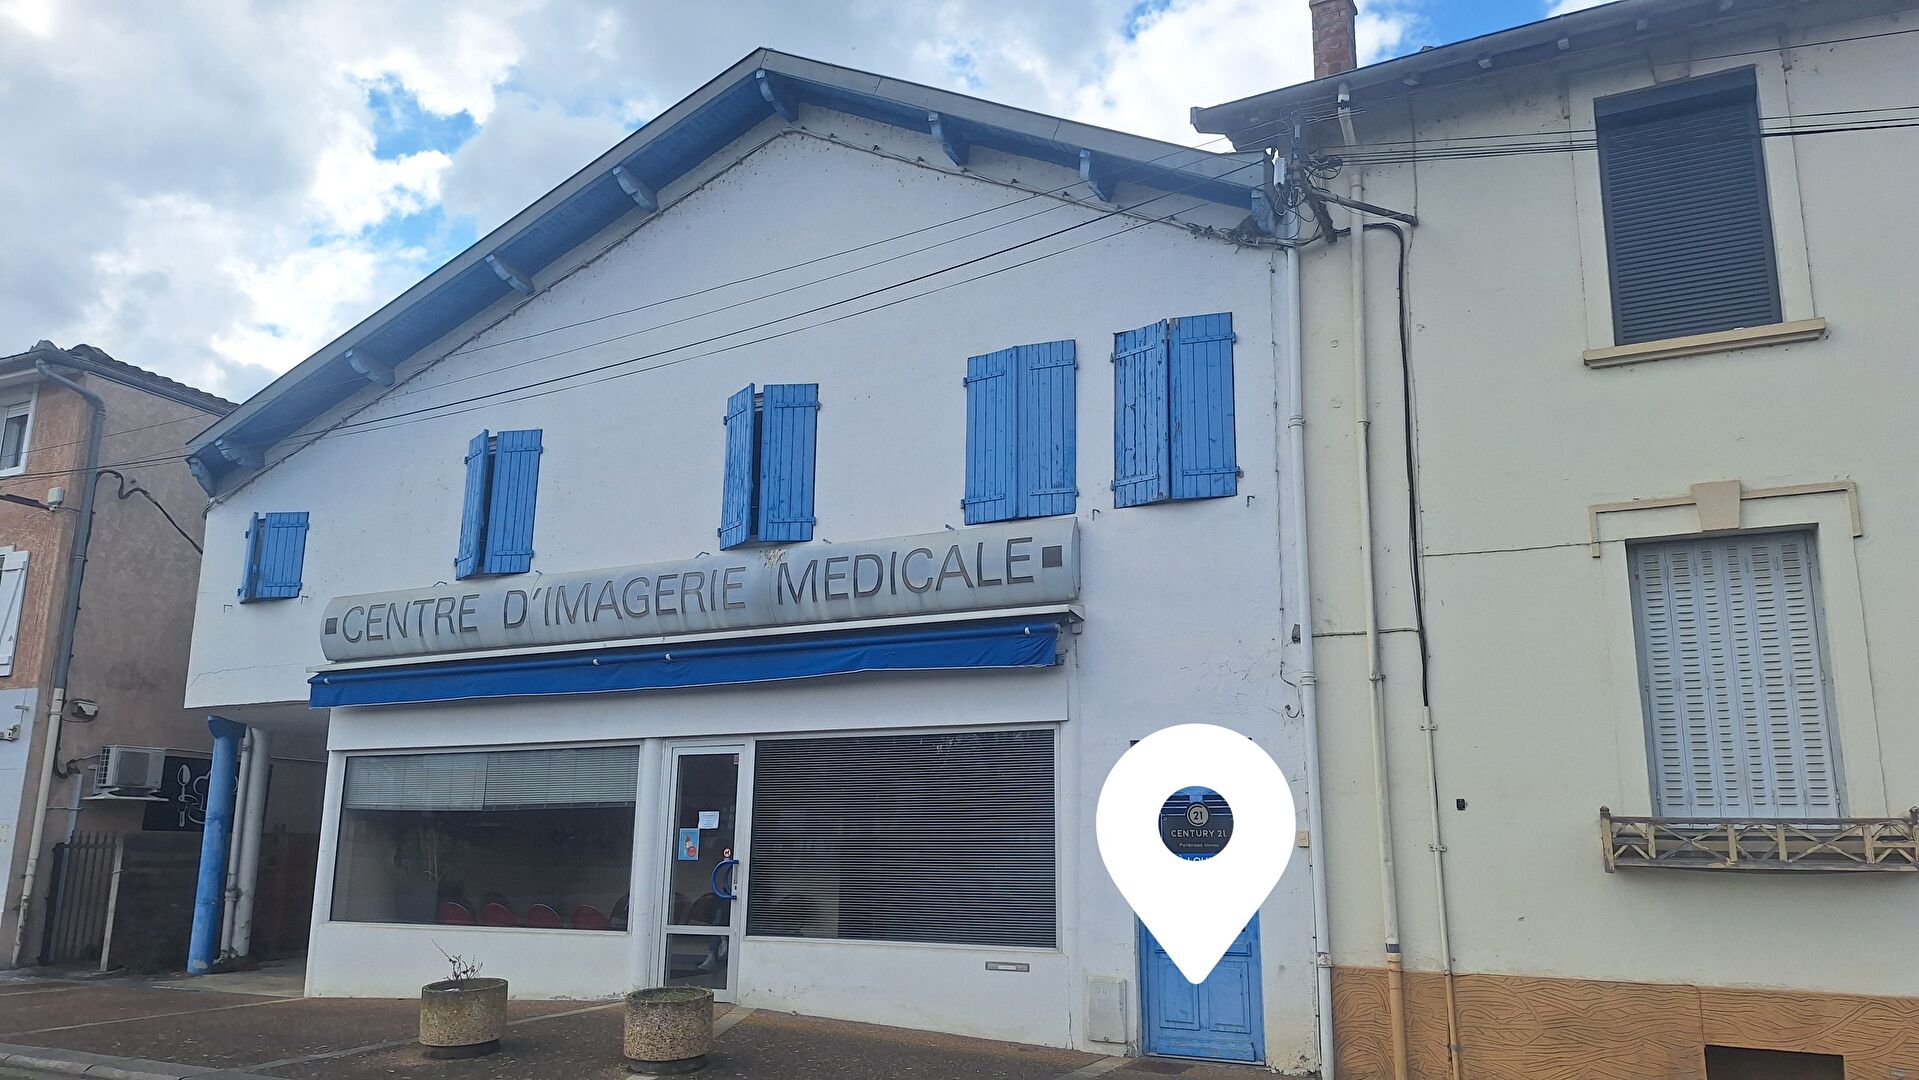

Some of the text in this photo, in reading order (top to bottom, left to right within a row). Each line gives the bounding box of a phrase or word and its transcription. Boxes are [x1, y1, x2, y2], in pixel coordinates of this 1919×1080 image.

[342, 536, 1035, 643] CENTRE D'IMAGERIE MEDICALE
[1192, 811, 1204, 821] 21
[1170, 829, 1226, 838] CENTURY 21
